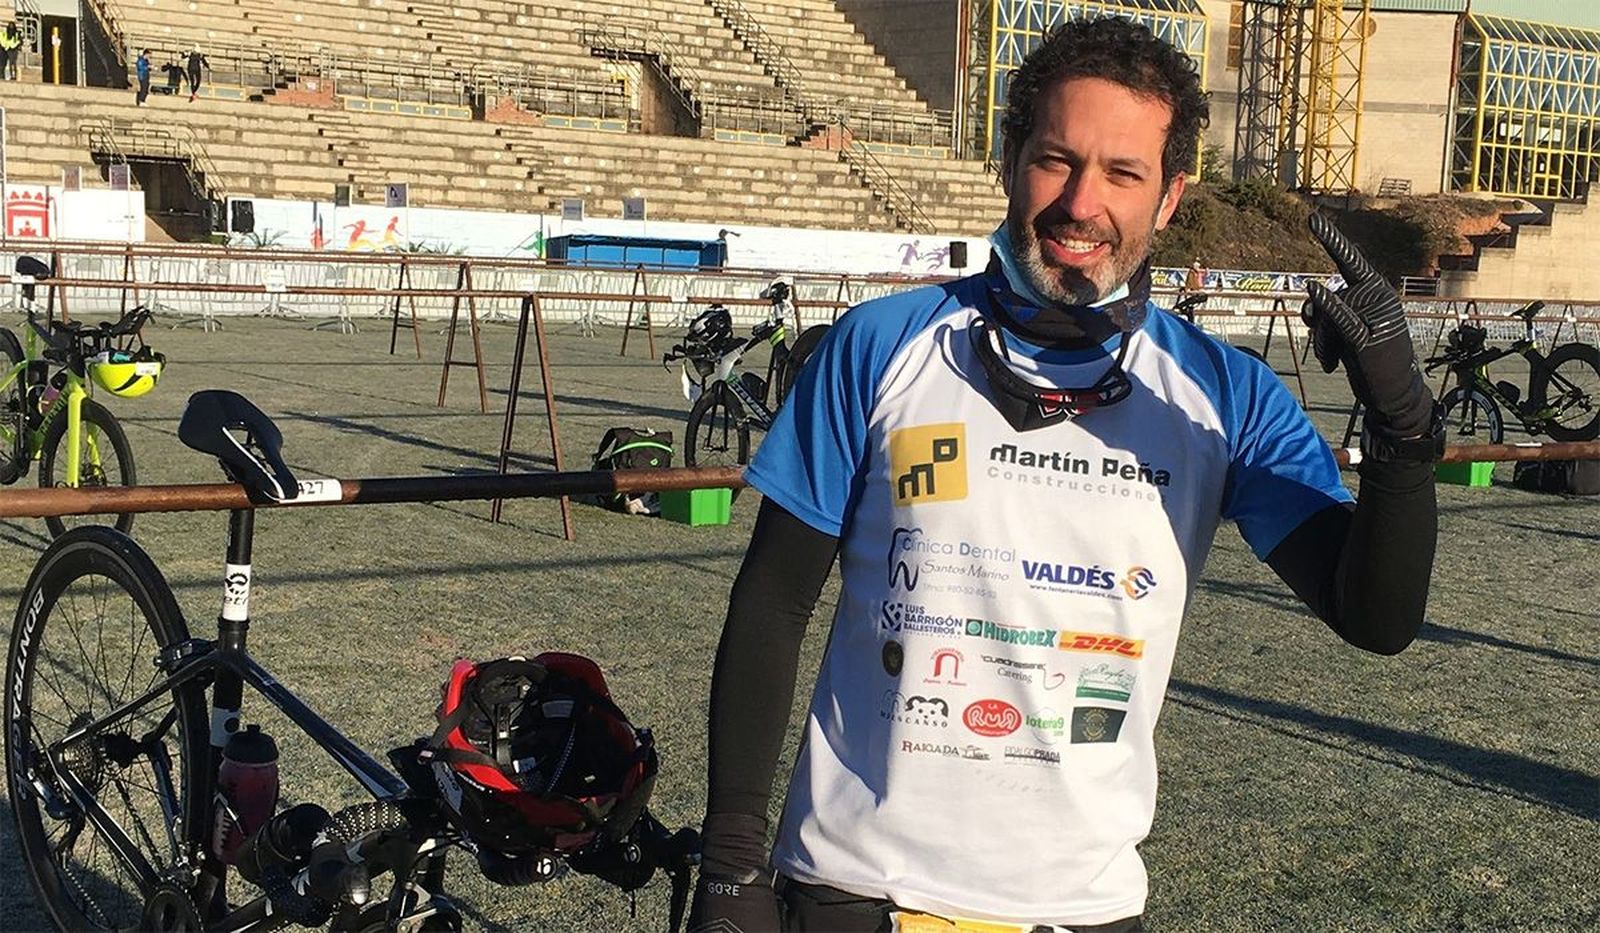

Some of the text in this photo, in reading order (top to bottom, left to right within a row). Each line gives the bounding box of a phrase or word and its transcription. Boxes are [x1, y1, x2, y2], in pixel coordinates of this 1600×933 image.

[1102, 456, 1171, 487] Peña
[960, 541, 1016, 562] Dental
[920, 560, 966, 574] Santos
[1022, 559, 1115, 590] VALDÉS
[905, 604, 926, 614] LUIS
[904, 613, 963, 628] BARRIGÓN
[1072, 636, 1136, 656] DHL
[707, 882, 740, 897] GORE
